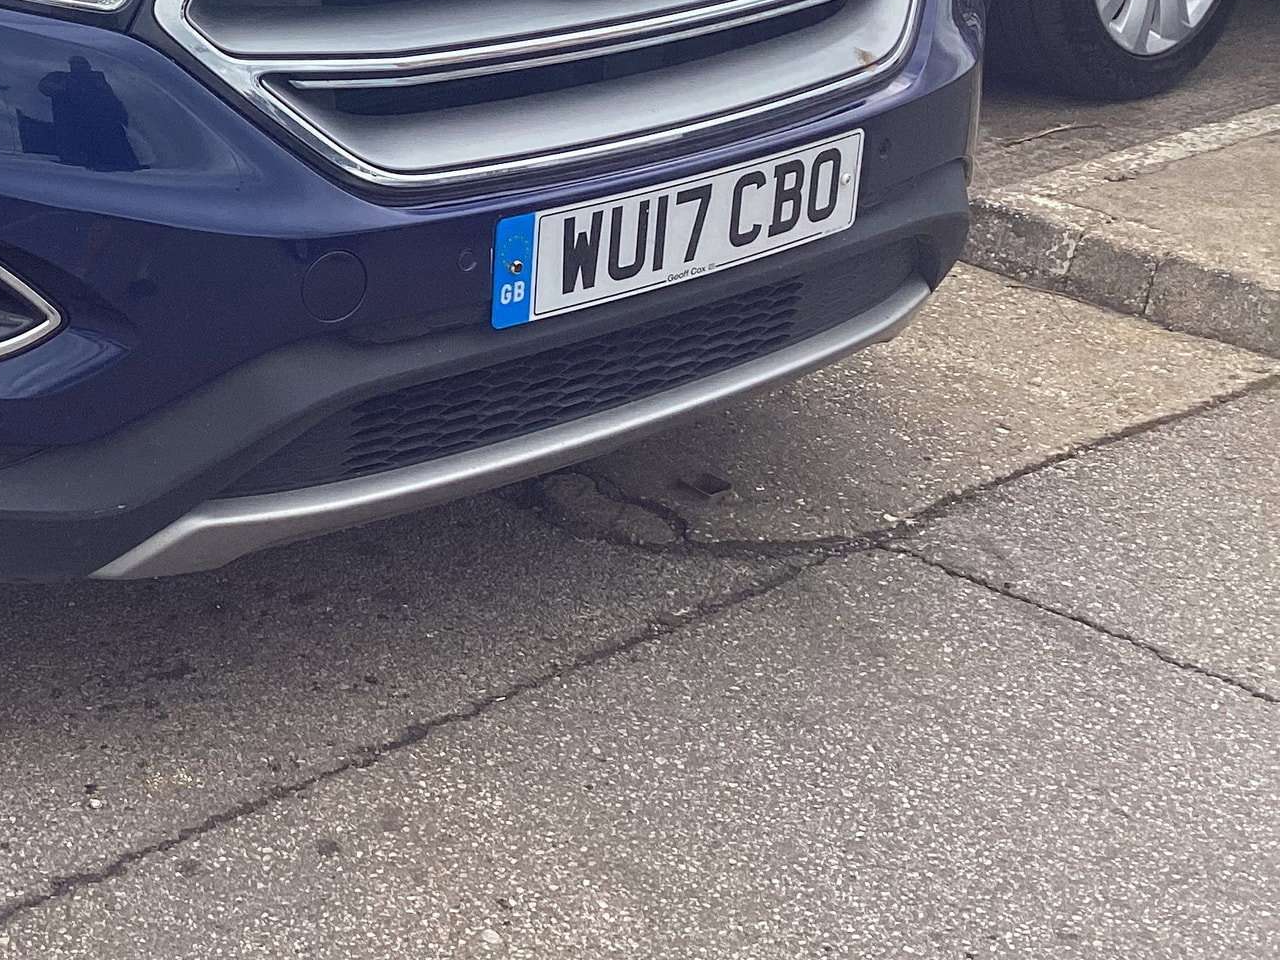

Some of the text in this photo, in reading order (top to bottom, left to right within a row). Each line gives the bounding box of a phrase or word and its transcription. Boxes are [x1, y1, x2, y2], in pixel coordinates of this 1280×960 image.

[562, 147, 842, 295] WU17 CBO
[667, 269, 689, 282] Geoff
[500, 280, 525, 305] GB
